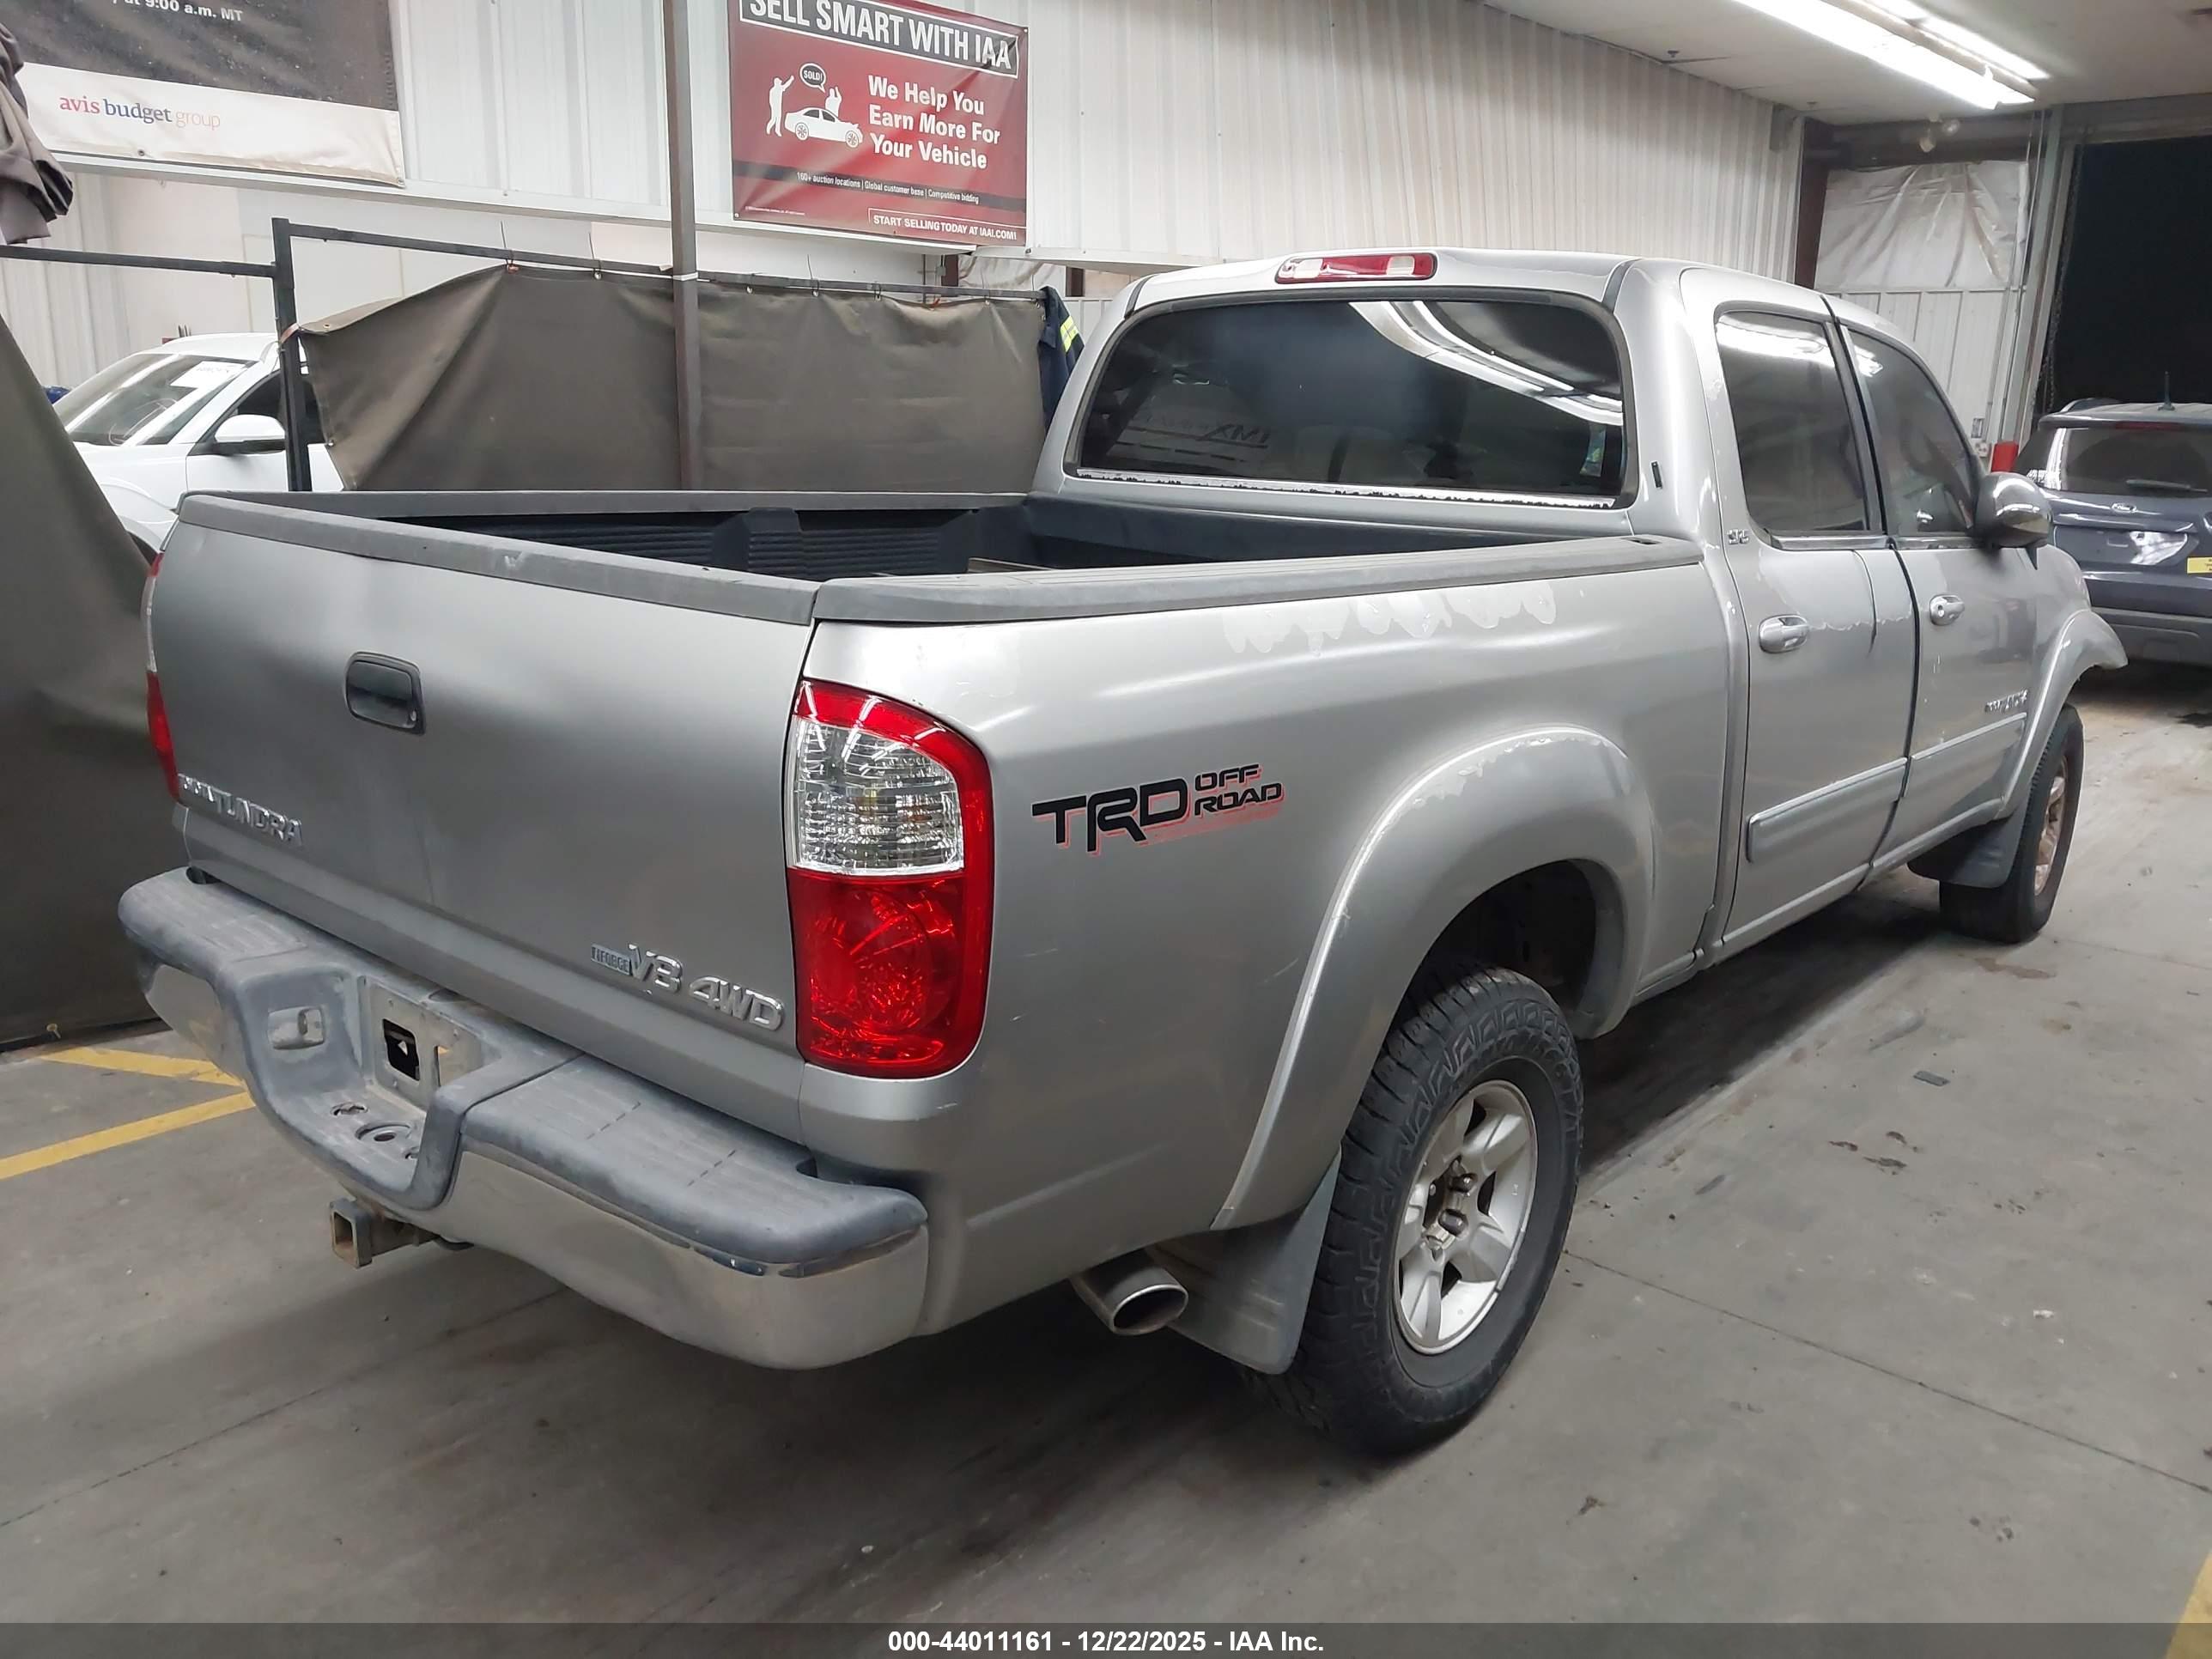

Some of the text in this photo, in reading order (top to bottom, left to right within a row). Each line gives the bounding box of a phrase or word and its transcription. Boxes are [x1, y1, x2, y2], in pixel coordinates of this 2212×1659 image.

[145, 0, 179, 11] 9:00
[184, 4, 216, 17] a.m.
[220, 8, 243, 21] MT
[750, 0, 1012, 69] SELL SMART WITH IAA
[804, 70, 823, 82] SOLD!
[59, 96, 221, 130] avis budget group
[868, 76, 984, 115] We Help You
[869, 104, 1000, 144] Earn More For
[870, 133, 988, 169] Your Vehicle
[812, 175, 834, 185] auction
[835, 177, 861, 188] locations
[865, 180, 883, 191] Global
[884, 184, 910, 195] customer
[910, 186, 924, 197] base
[928, 189, 961, 200] Competitive
[961, 192, 979, 204] bidding
[873, 215, 902, 227] START
[904, 219, 940, 232] SELLING
[940, 222, 968, 234] TODAY
[969, 226, 979, 236] AT
[1194, 763, 1260, 792] OFF
[1031, 778, 1188, 852] TRD
[1194, 782, 1282, 817] ROAD
[629, 943, 683, 993] V8
[690, 975, 785, 1030] 4WD
